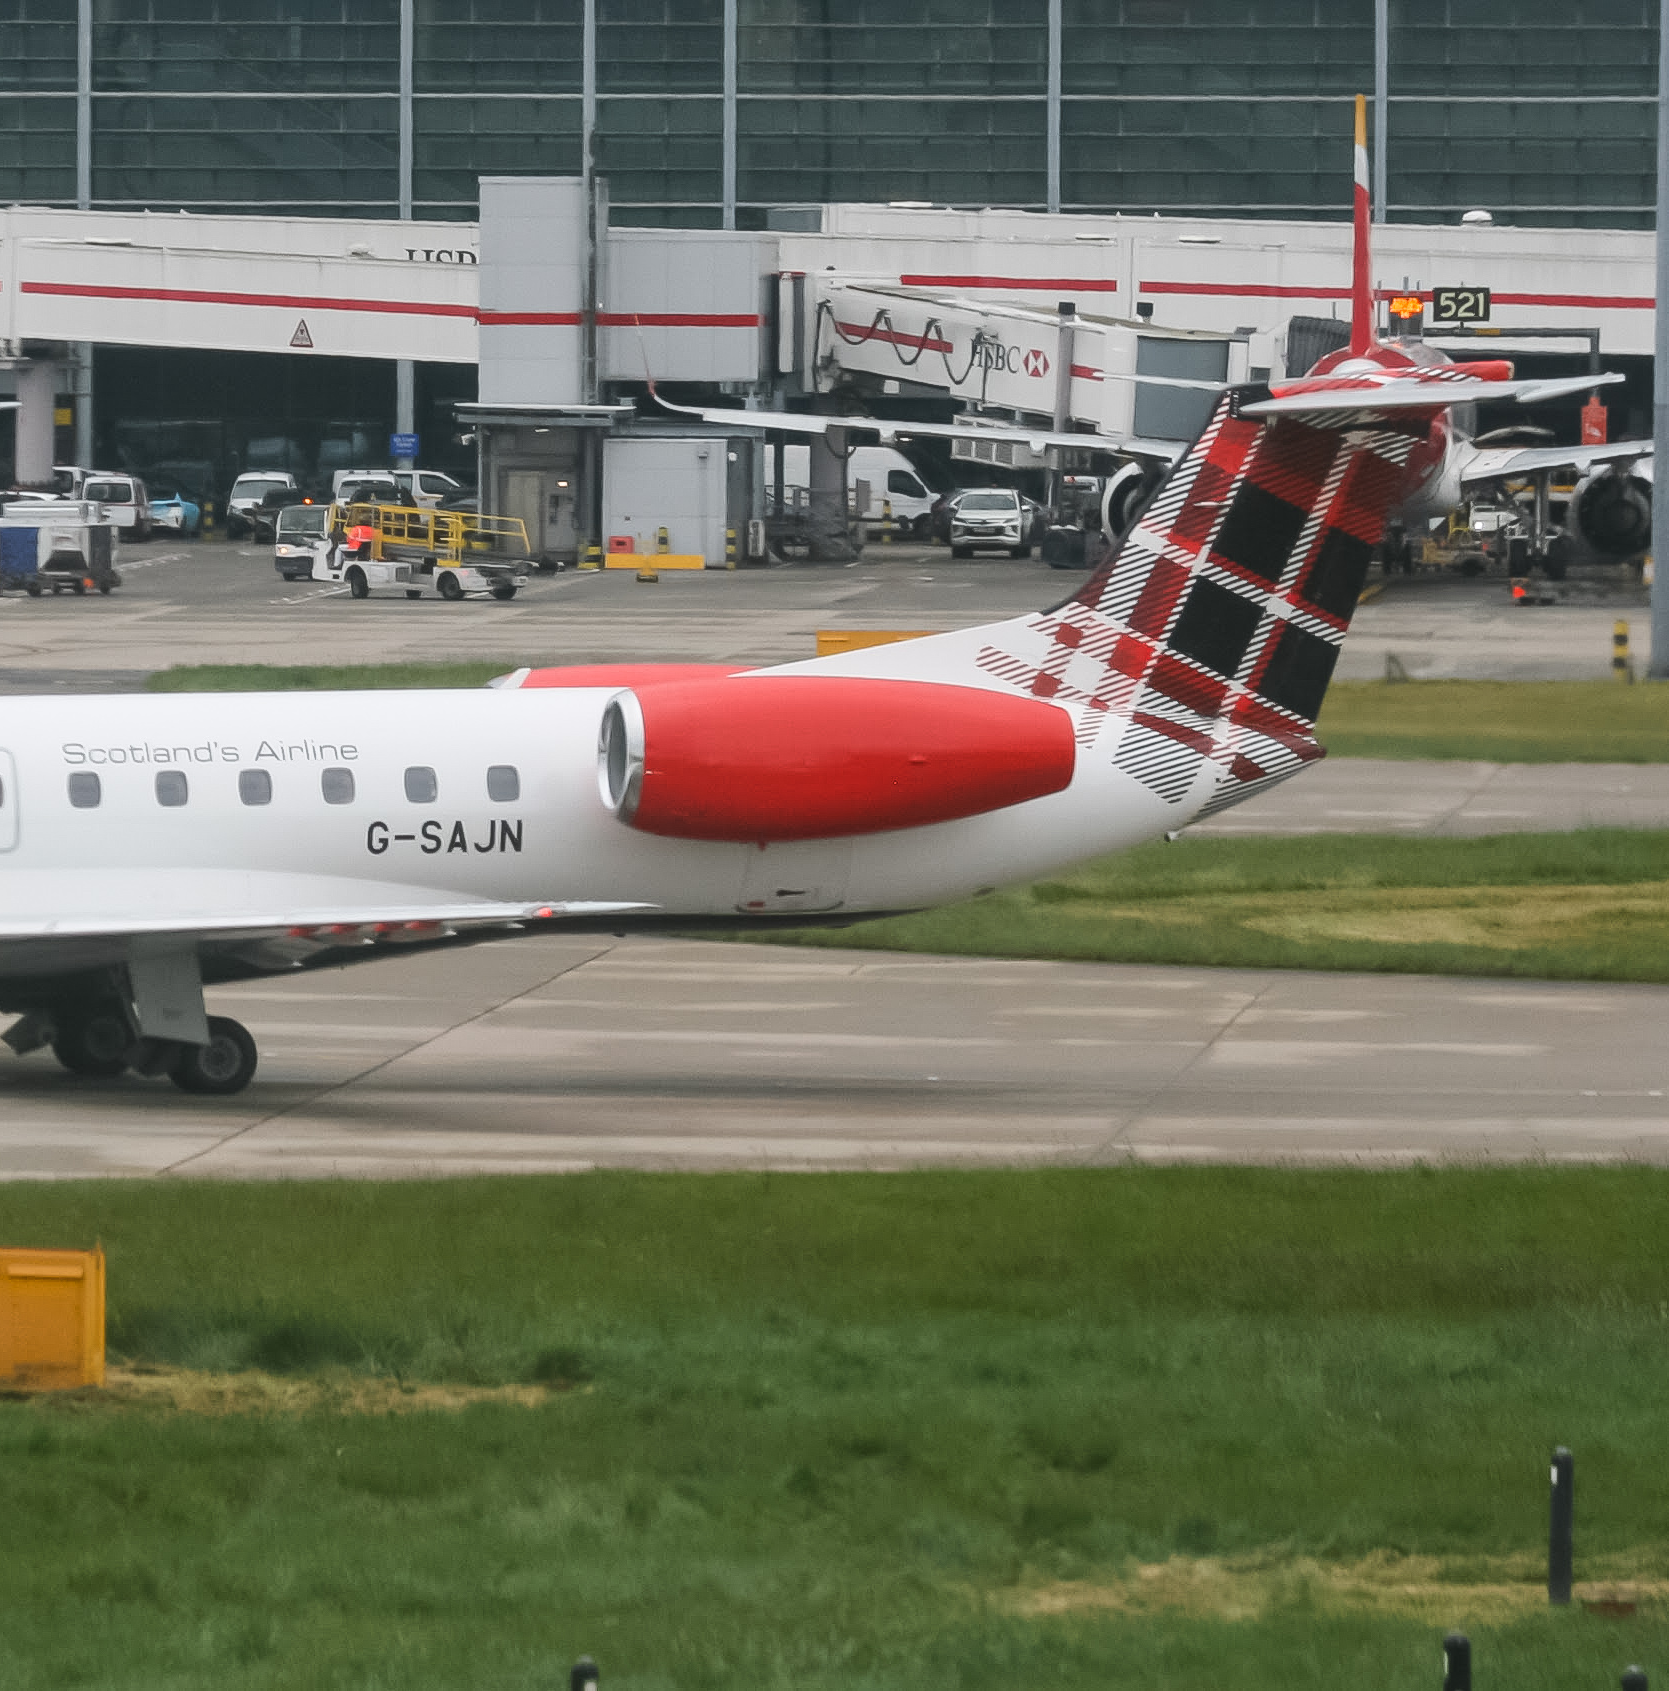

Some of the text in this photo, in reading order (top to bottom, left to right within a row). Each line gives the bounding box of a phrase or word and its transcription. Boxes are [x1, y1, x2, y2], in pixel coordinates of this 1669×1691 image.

[1439, 292, 1485, 318] 521
[62, 739, 359, 764] Scotland's Airline
[367, 819, 523, 854] G-SAJN
